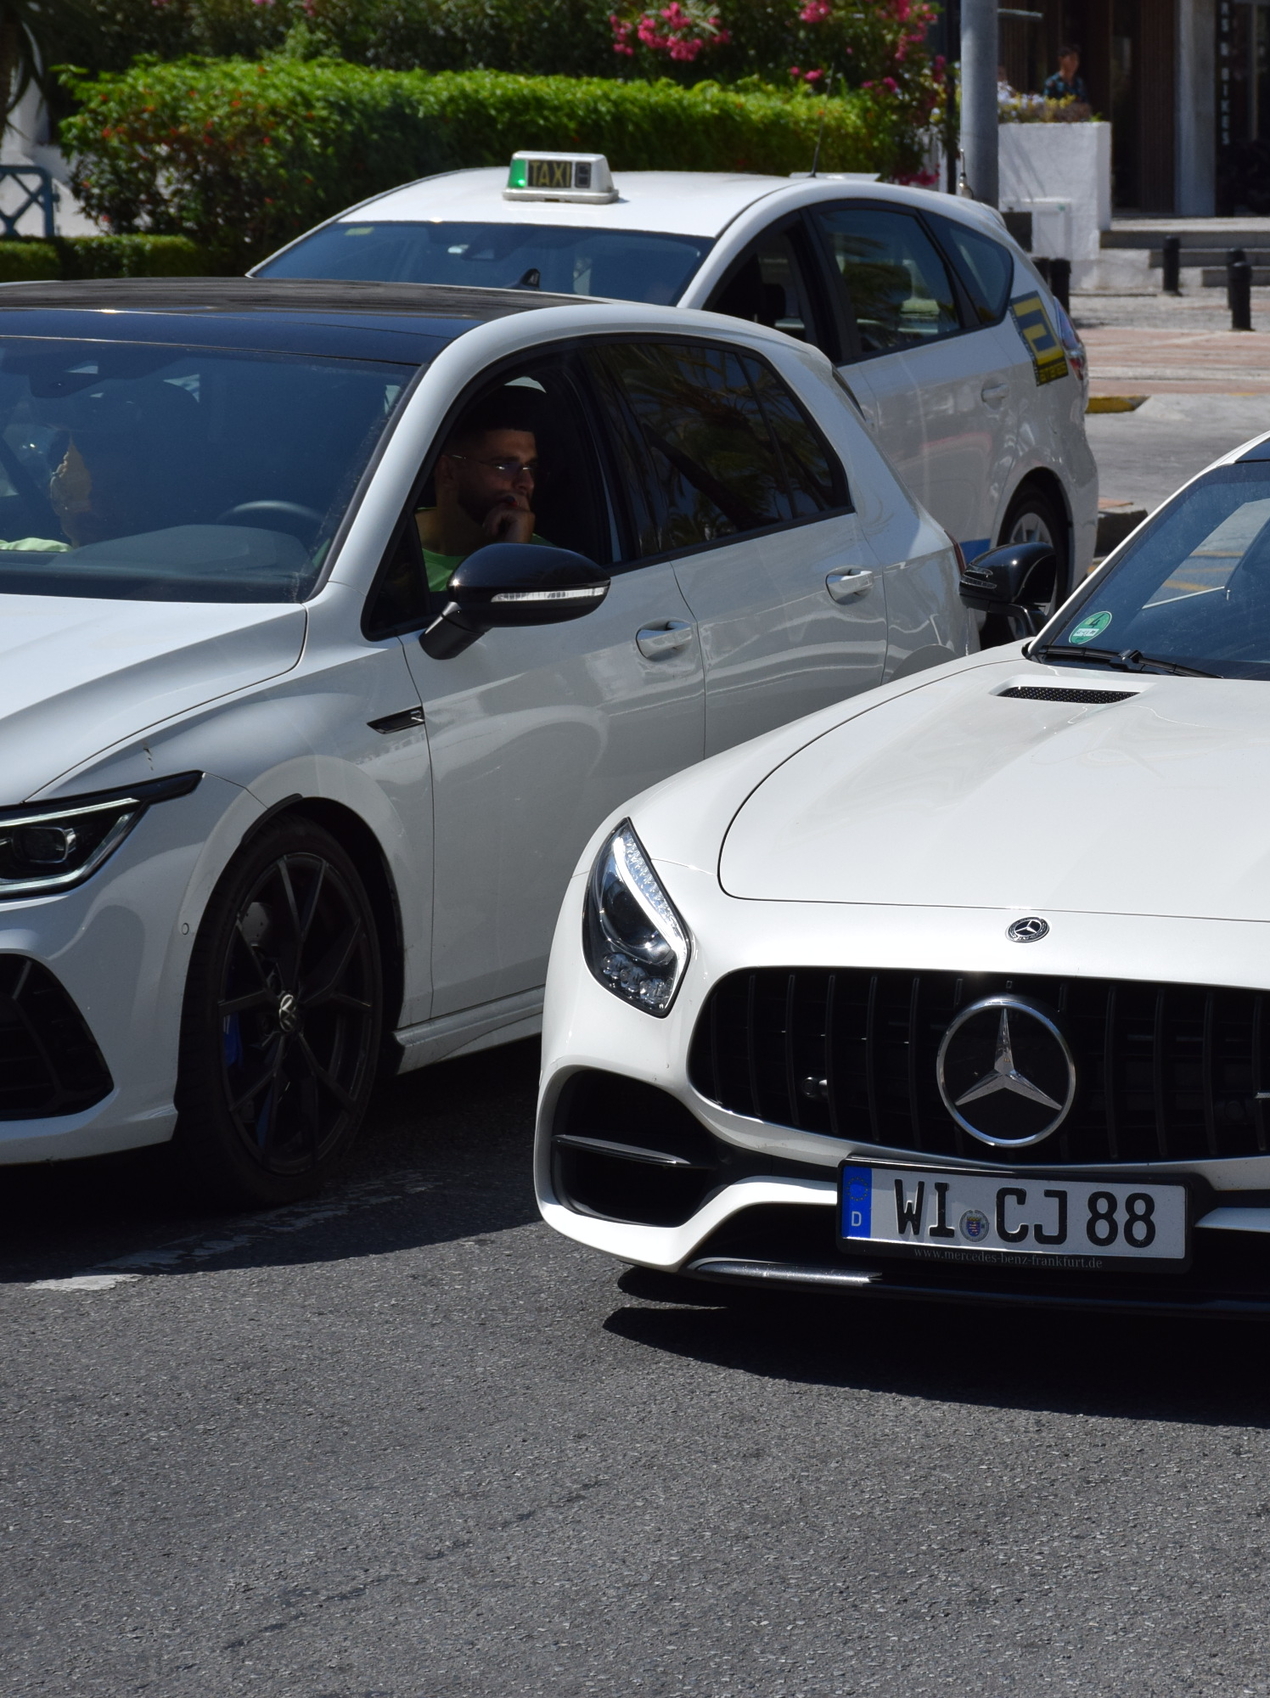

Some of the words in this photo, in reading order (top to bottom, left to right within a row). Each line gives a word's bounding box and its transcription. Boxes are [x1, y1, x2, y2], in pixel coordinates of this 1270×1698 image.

[1221, 67, 1230, 145] BIKES
[529, 161, 572, 188] TAXI
[851, 1210, 863, 1227] D
[894, 1178, 955, 1239] WI
[996, 1186, 1068, 1245] CJ
[1086, 1190, 1157, 1249] 88
[914, 1247, 1103, 1269] www.mercedes-benz-frankfurt.de
